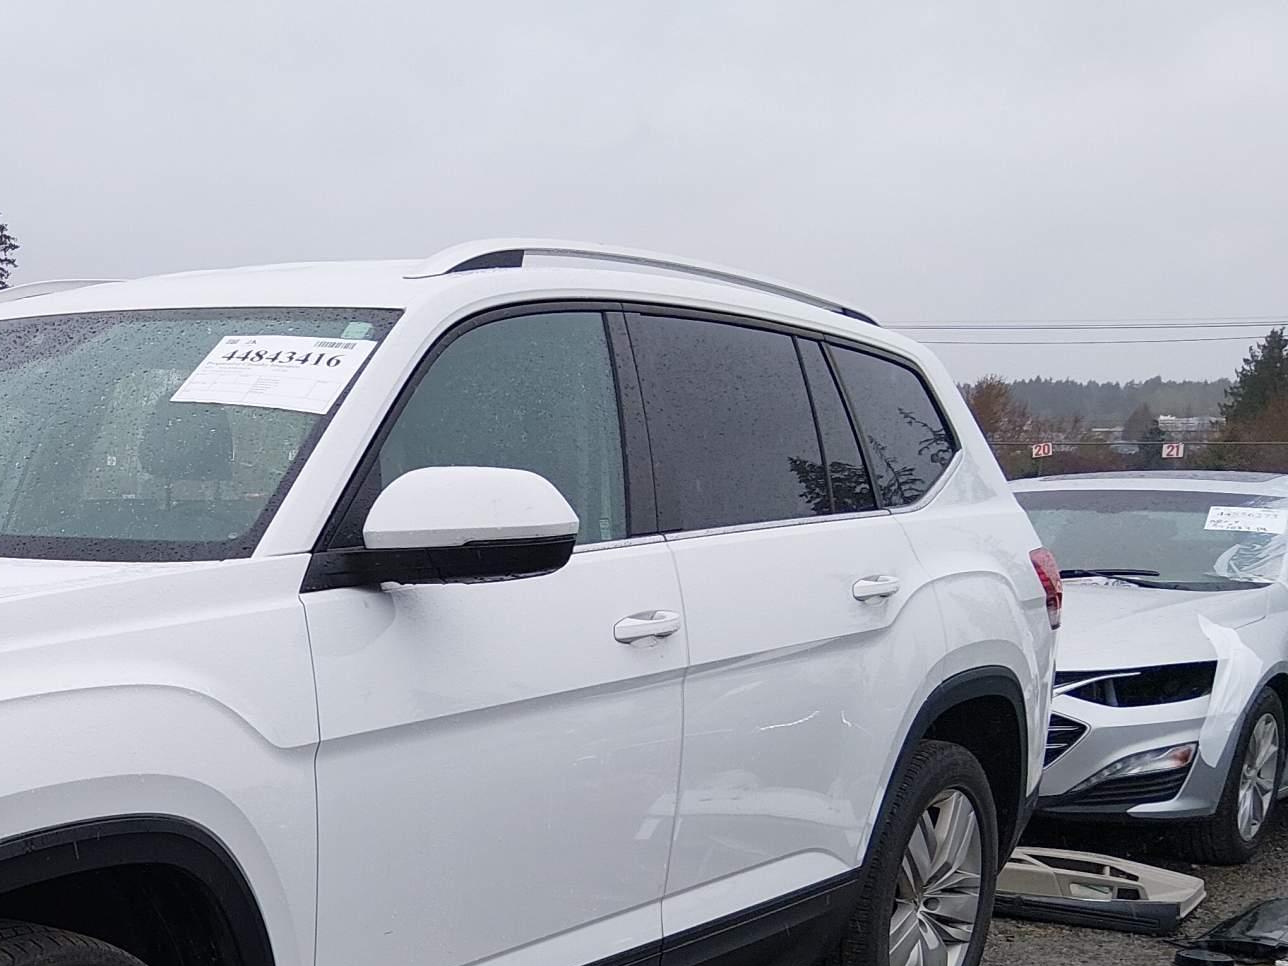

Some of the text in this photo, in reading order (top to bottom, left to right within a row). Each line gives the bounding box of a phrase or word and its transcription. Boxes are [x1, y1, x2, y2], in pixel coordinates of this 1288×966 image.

[221, 349, 344, 368] 44843416
[1034, 444, 1051, 457] 20
[1166, 444, 1180, 457] 21
